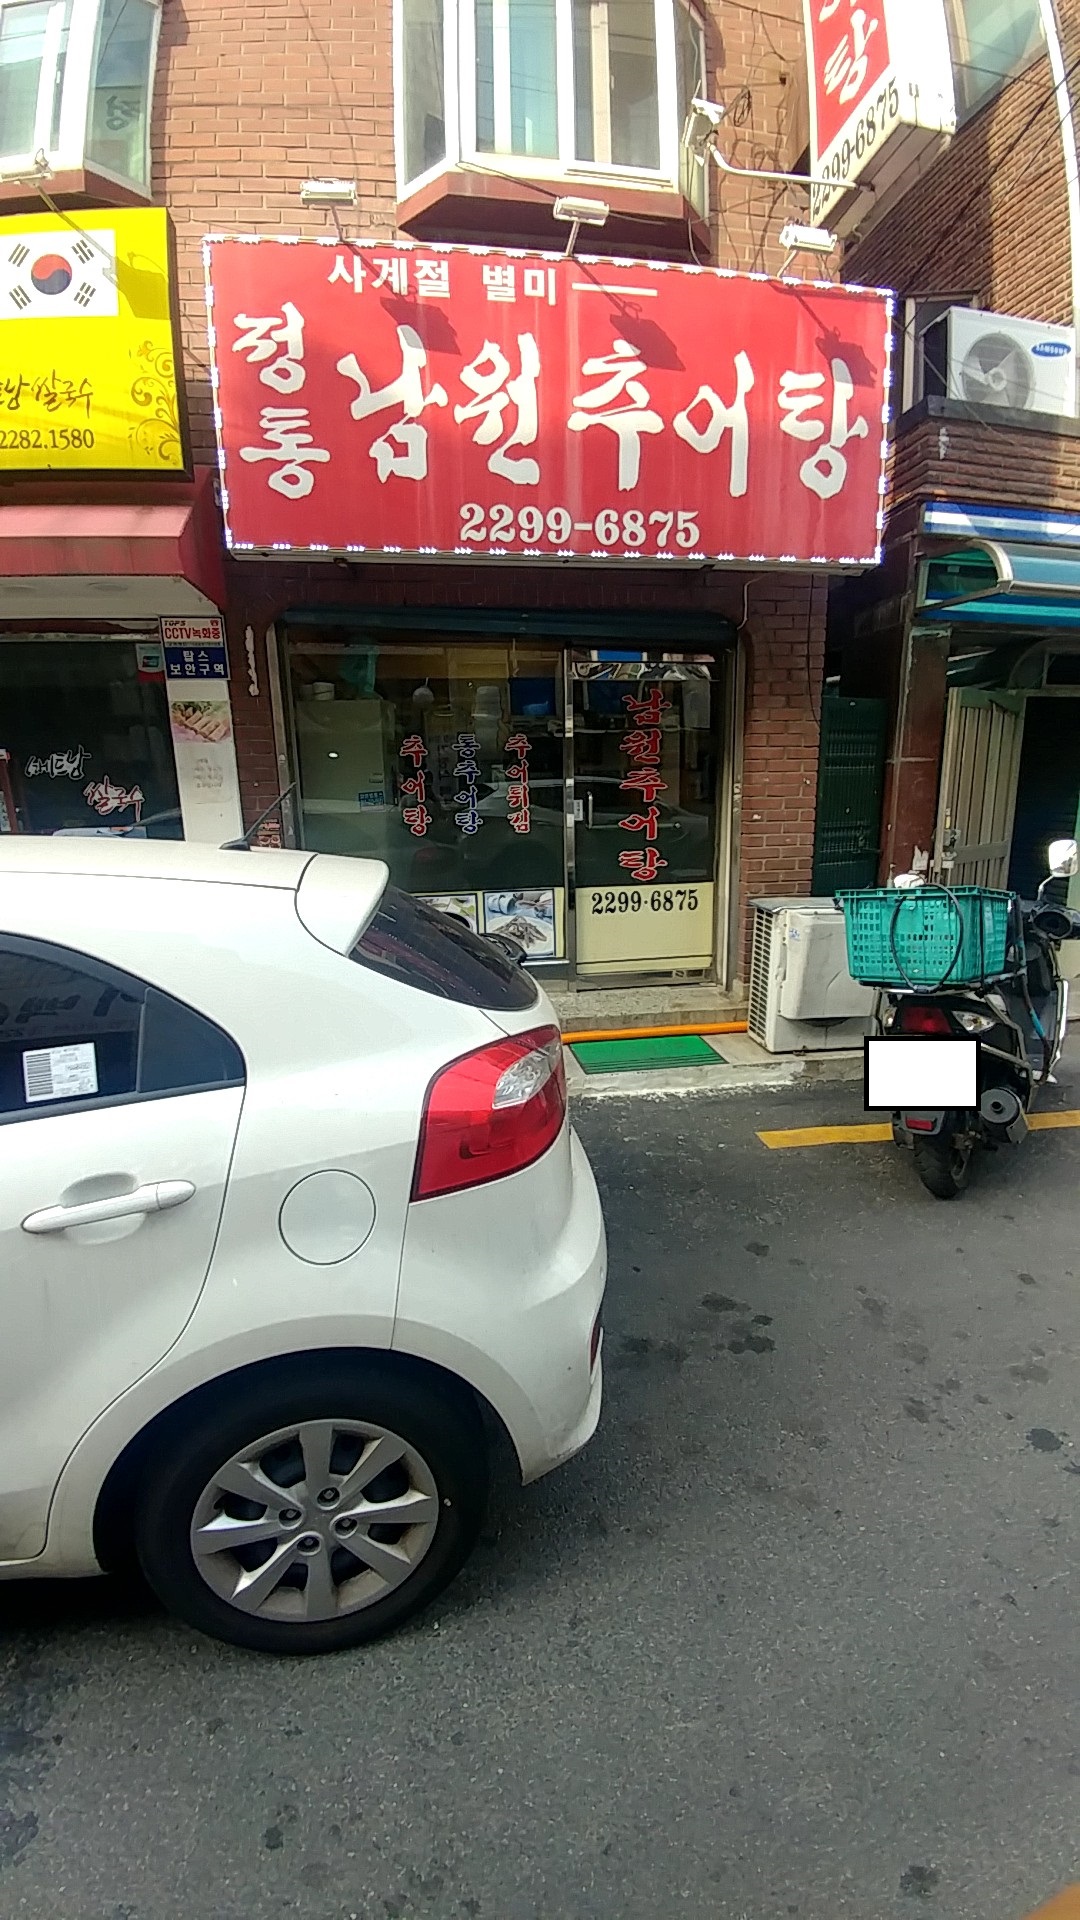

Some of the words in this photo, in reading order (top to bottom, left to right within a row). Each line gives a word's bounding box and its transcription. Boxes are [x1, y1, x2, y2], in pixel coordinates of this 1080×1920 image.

[818, 0, 879, 105] 탕
[327, 255, 451, 299] 사계절
[482, 263, 557, 306] 별미
[31, 369, 94, 419] 쌀국수
[231, 301, 331, 500] 정통
[335, 324, 870, 501] 남원추어탕
[459, 502, 701, 549] 2299-6875
[169, 663, 225, 676] 보안구역
[82, 774, 146, 823] 쌀국수
[400, 734, 433, 837] 추어탕
[504, 733, 532, 834] 추어튀김
[618, 688, 672, 882] 남원추어탕
